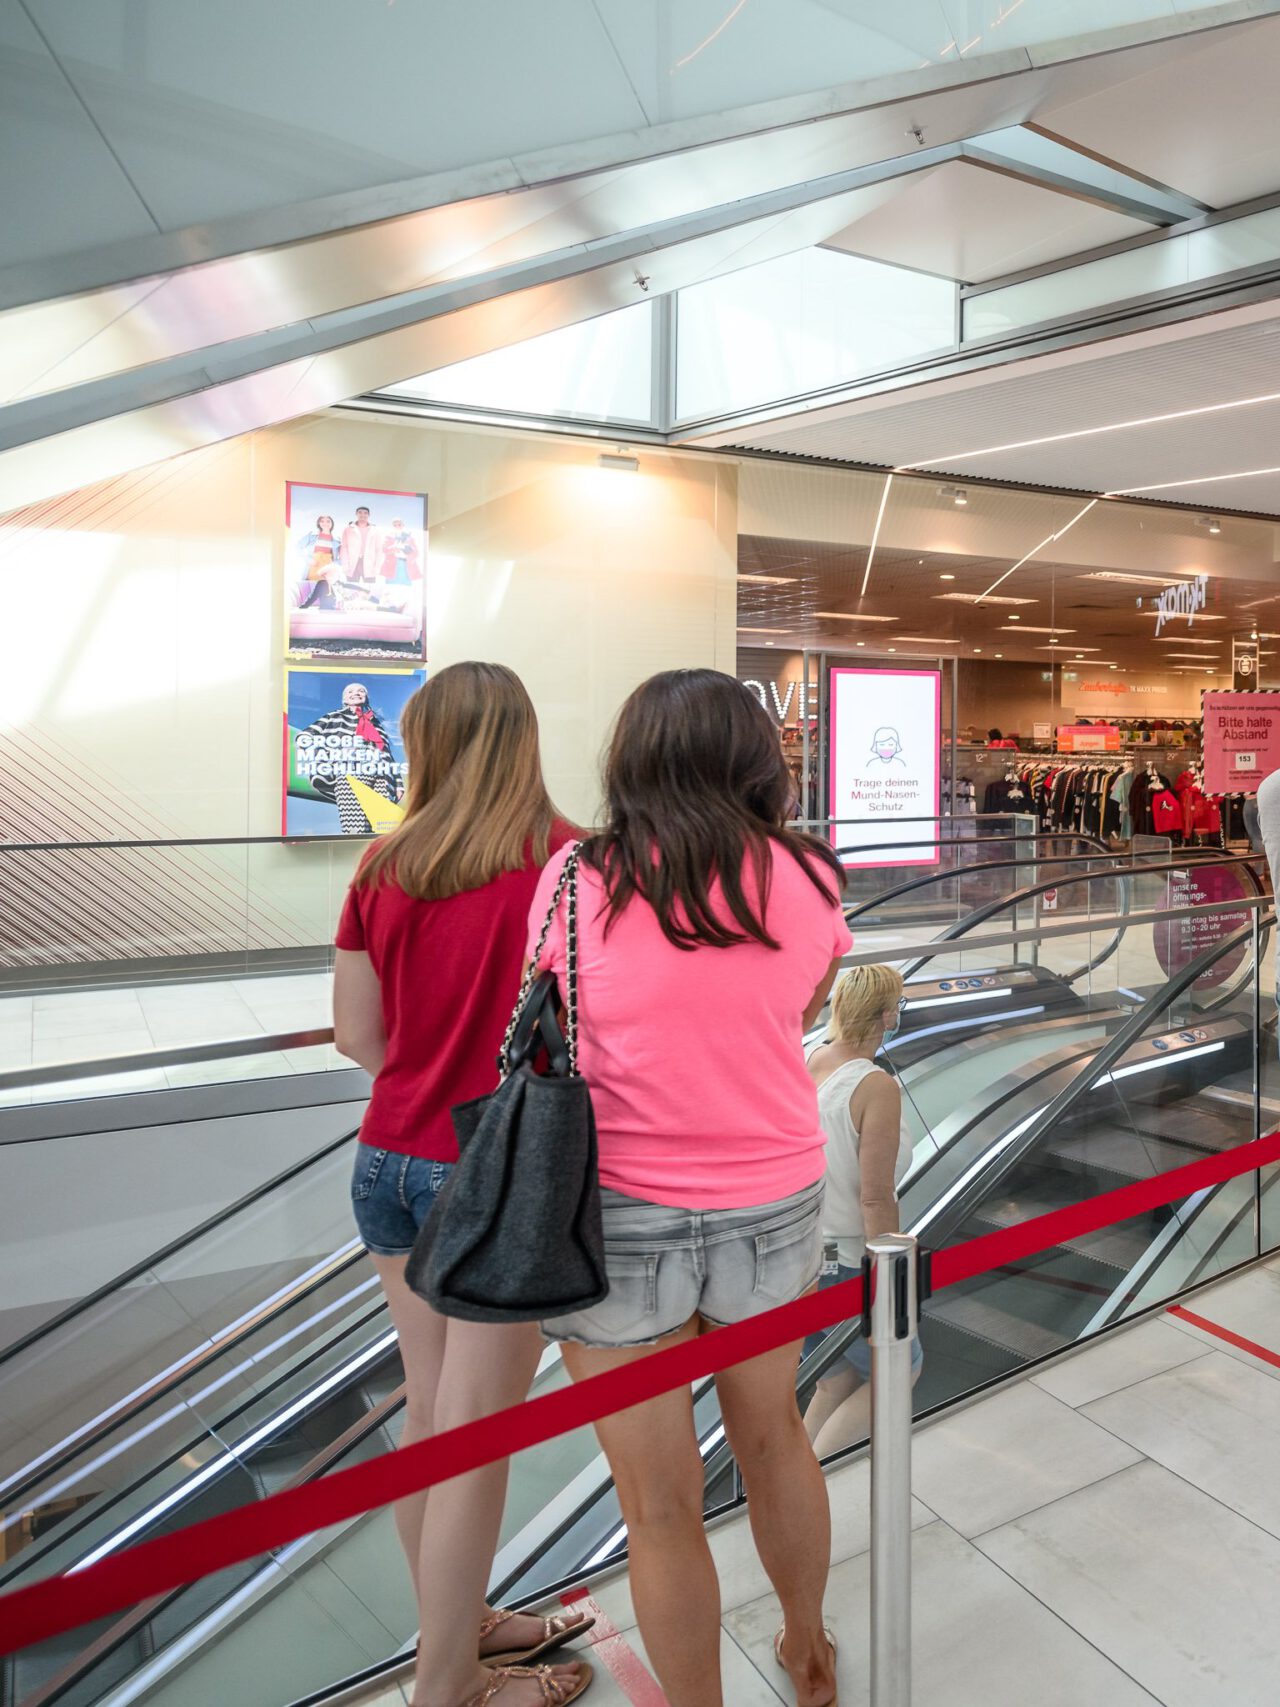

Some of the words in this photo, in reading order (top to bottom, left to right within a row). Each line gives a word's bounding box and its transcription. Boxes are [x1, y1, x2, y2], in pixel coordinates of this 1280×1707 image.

[1218, 716, 1244, 728] Bitte
[1246, 716, 1272, 728] halte
[1223, 728, 1268, 740] Abstand
[297, 762, 409, 776] HIGHLIGHTS
[853, 779, 882, 788] Trage
[885, 779, 919, 788] deinen
[851, 791, 920, 800] Mund-Nasen-
[868, 802, 903, 812] Schutz
[1172, 883, 1198, 892] unsere
[1208, 914, 1219, 922] bis
[1220, 912, 1247, 920] samstag
[1209, 922, 1221, 930] uhr
